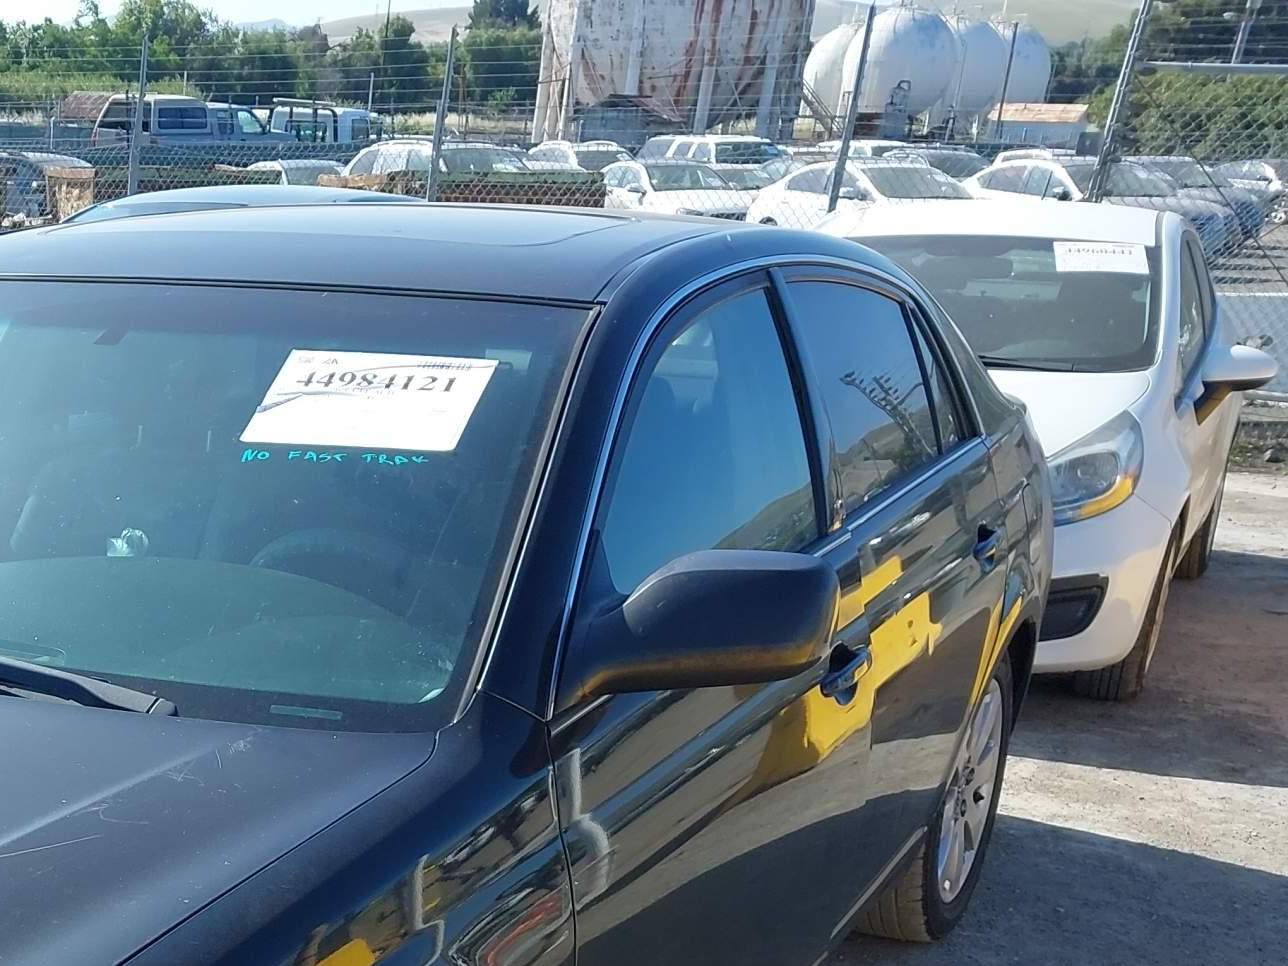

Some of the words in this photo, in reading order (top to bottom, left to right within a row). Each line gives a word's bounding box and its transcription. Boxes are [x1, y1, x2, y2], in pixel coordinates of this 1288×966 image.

[295, 370, 458, 393] 44984121
[241, 449, 271, 463] NO
[287, 450, 348, 463] FAST
